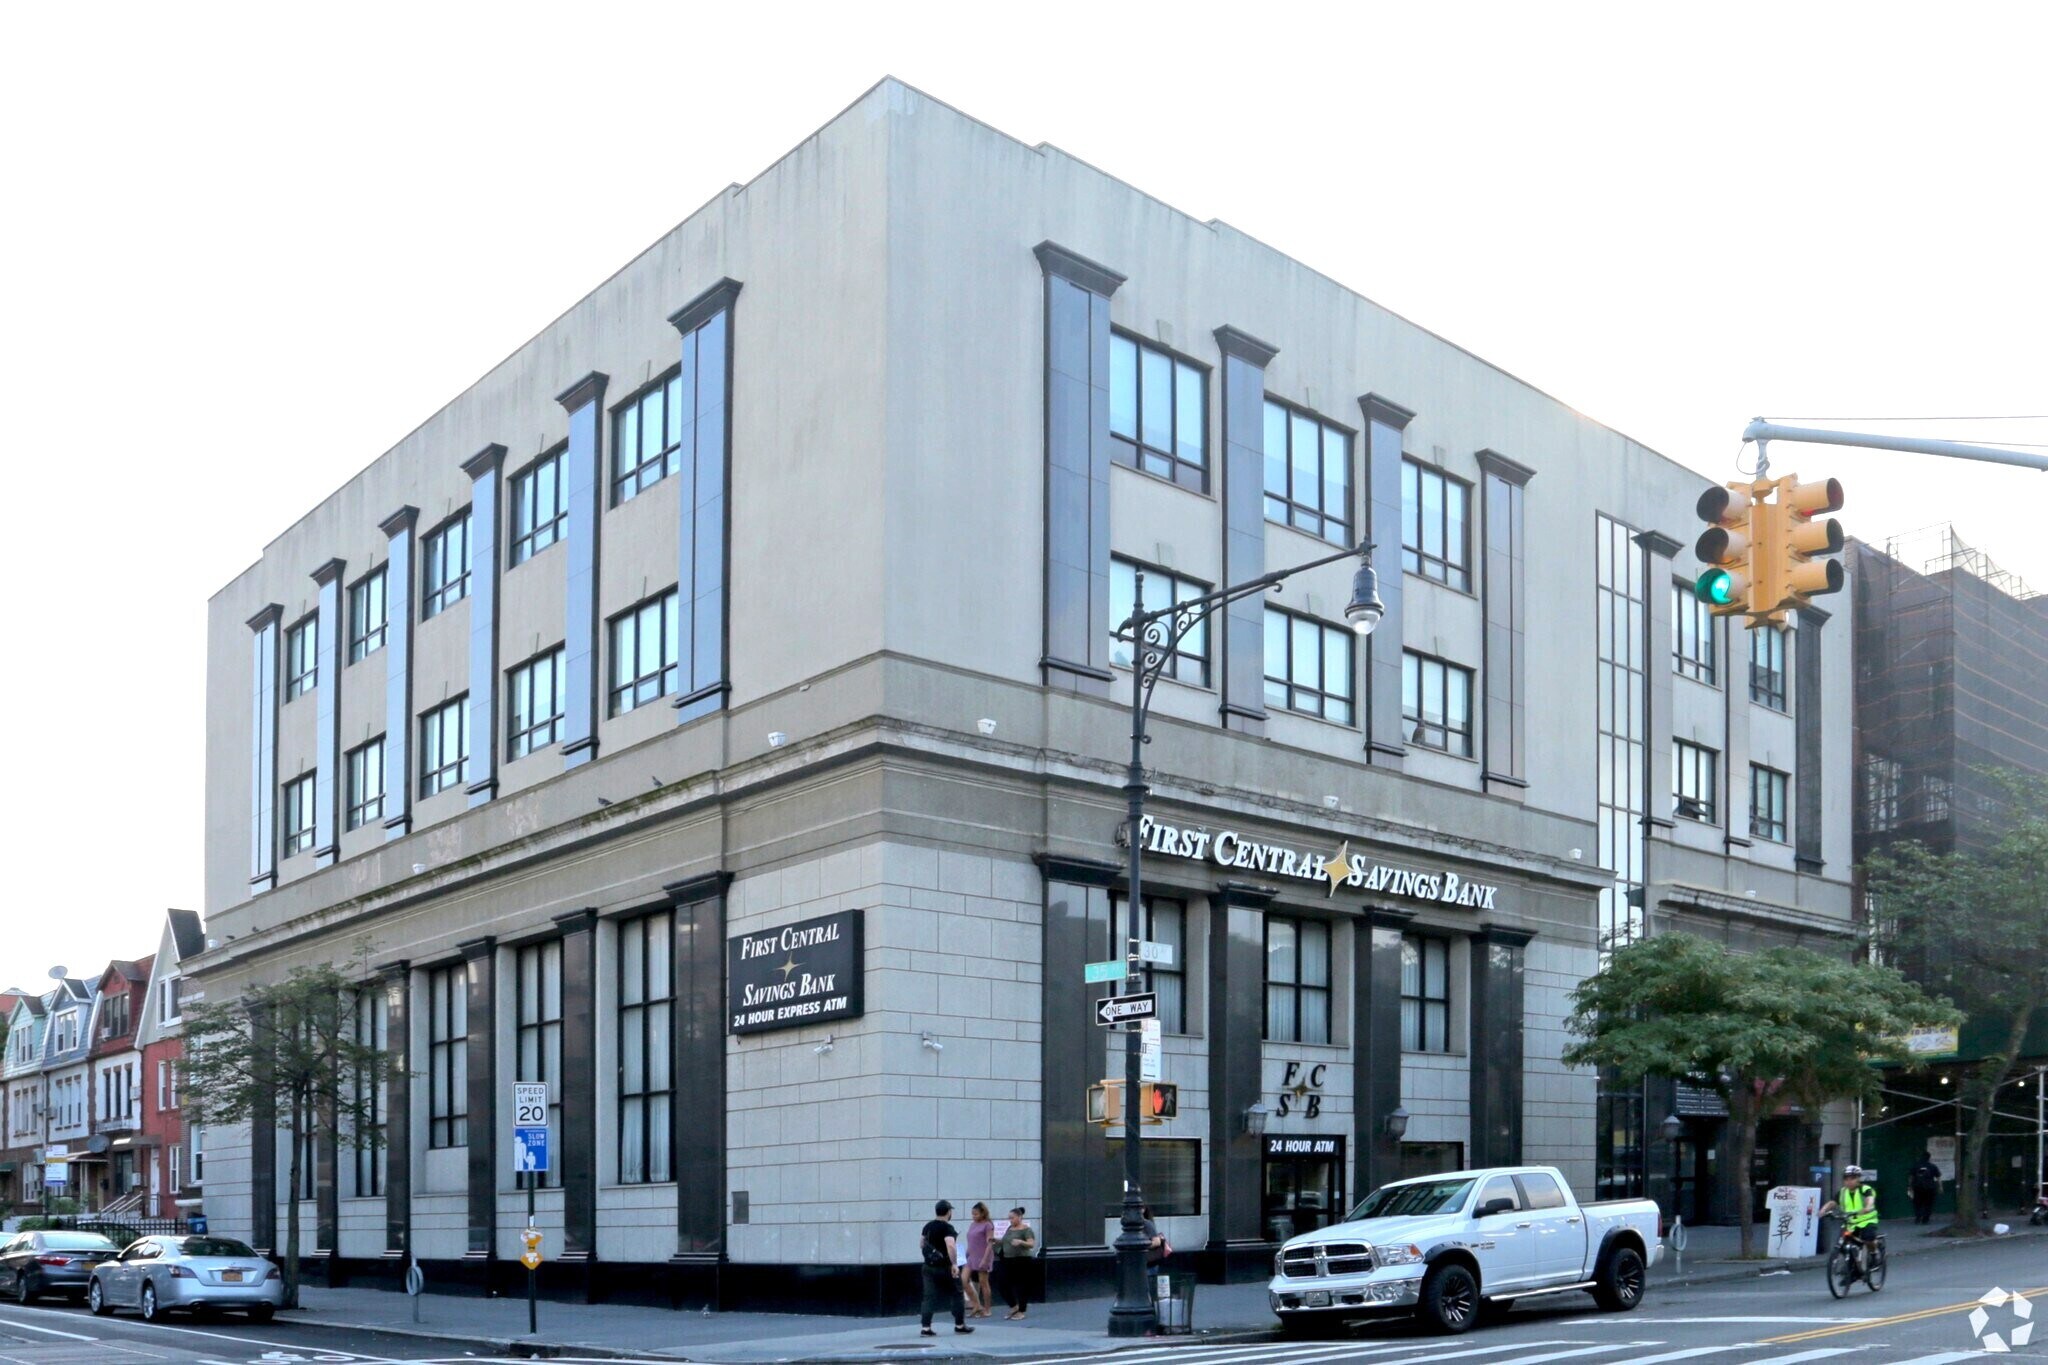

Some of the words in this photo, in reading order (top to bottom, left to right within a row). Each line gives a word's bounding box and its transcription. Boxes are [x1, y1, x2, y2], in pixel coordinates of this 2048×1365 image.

[1139, 814, 1210, 860] FIRST
[1214, 831, 1328, 881] CENTRAL
[1347, 854, 1440, 900] SAVINGS
[1441, 872, 1498, 910] BANK
[741, 937, 778, 960] FIRST
[781, 923, 840, 951] CENTRAL
[743, 981, 796, 1006] SAVINGS
[799, 973, 835, 997] BANK
[734, 1014, 745, 1027] 24
[748, 1009, 774, 1025] HOUR
[777, 1001, 821, 1020] EXPRESS
[823, 996, 848, 1012] ATM
[1106, 1005, 1122, 1016] ONE
[1130, 1001, 1148, 1014] WAY
[1282, 1062, 1300, 1086] F
[1310, 1064, 1326, 1088] C
[519, 1106, 544, 1121] 20
[1276, 1094, 1291, 1117] S
[1304, 1094, 1321, 1119] B
[1270, 1140, 1282, 1152] 24
[1285, 1141, 1312, 1153] HOUR
[1314, 1141, 1335, 1153] ATM
